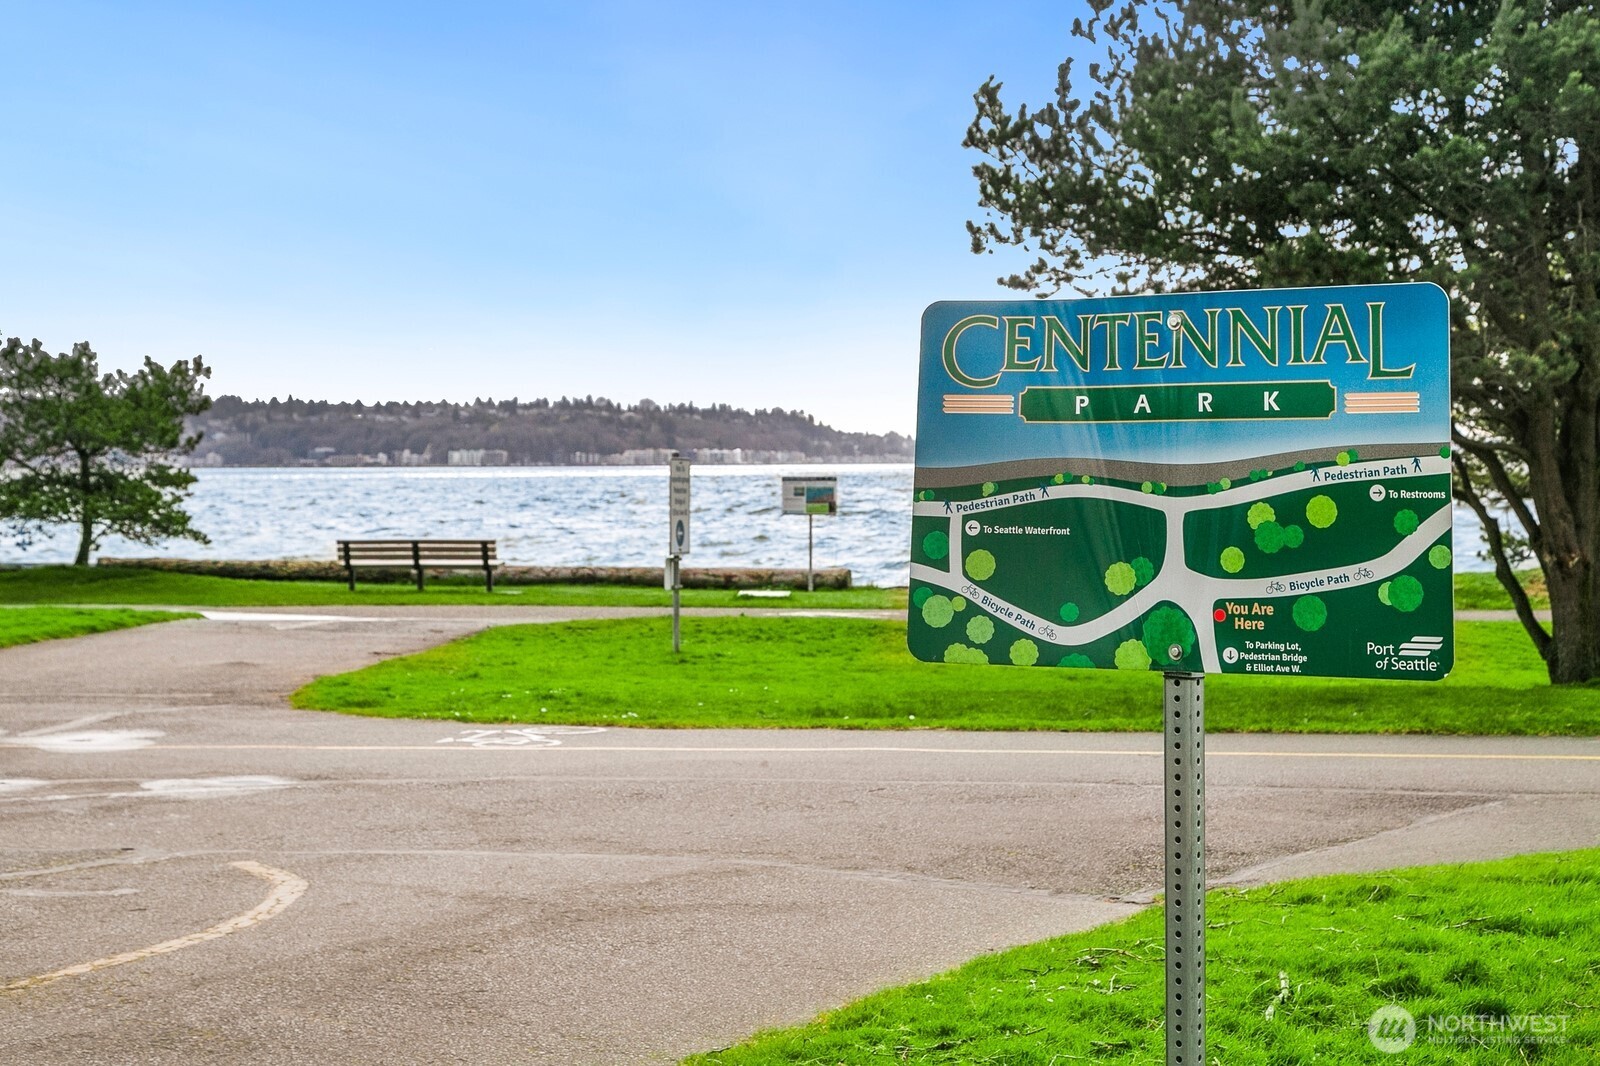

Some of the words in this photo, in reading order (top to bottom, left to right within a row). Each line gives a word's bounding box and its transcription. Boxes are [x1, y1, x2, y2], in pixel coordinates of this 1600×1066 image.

[942, 302, 1416, 389] CENTENNIAL
[1324, 468, 1380, 481] Pedestrian
[1383, 465, 1407, 476] Path
[1388, 490, 1398, 499] To
[1400, 490, 1446, 499] Restrooms
[956, 498, 1010, 512] Pedestrian
[1013, 492, 1036, 504] Path
[983, 525, 992, 534] To
[994, 526, 1023, 535] Seattle
[1025, 526, 1071, 535] Waterfront
[1289, 577, 1325, 591] Bicycle
[1327, 573, 1350, 585] Path
[981, 595, 1014, 618] Bicycle
[1014, 613, 1036, 630] Path
[1226, 602, 1249, 615] You
[1251, 602, 1274, 615] Are
[1234, 617, 1265, 630] Here
[1245, 641, 1254, 649] To
[1255, 641, 1285, 651] Parking
[1286, 642, 1302, 651] Lot,
[1367, 642, 1395, 656] Port
[1239, 652, 1281, 661] Pedestrian
[1282, 653, 1308, 662] Bridge
[1245, 663, 1252, 671] &
[1253, 663, 1274, 672] Elliot
[1276, 664, 1290, 672] Ave
[1291, 664, 1302, 673] W.
[1375, 657, 1389, 670] of
[1391, 657, 1437, 671] Seattle
